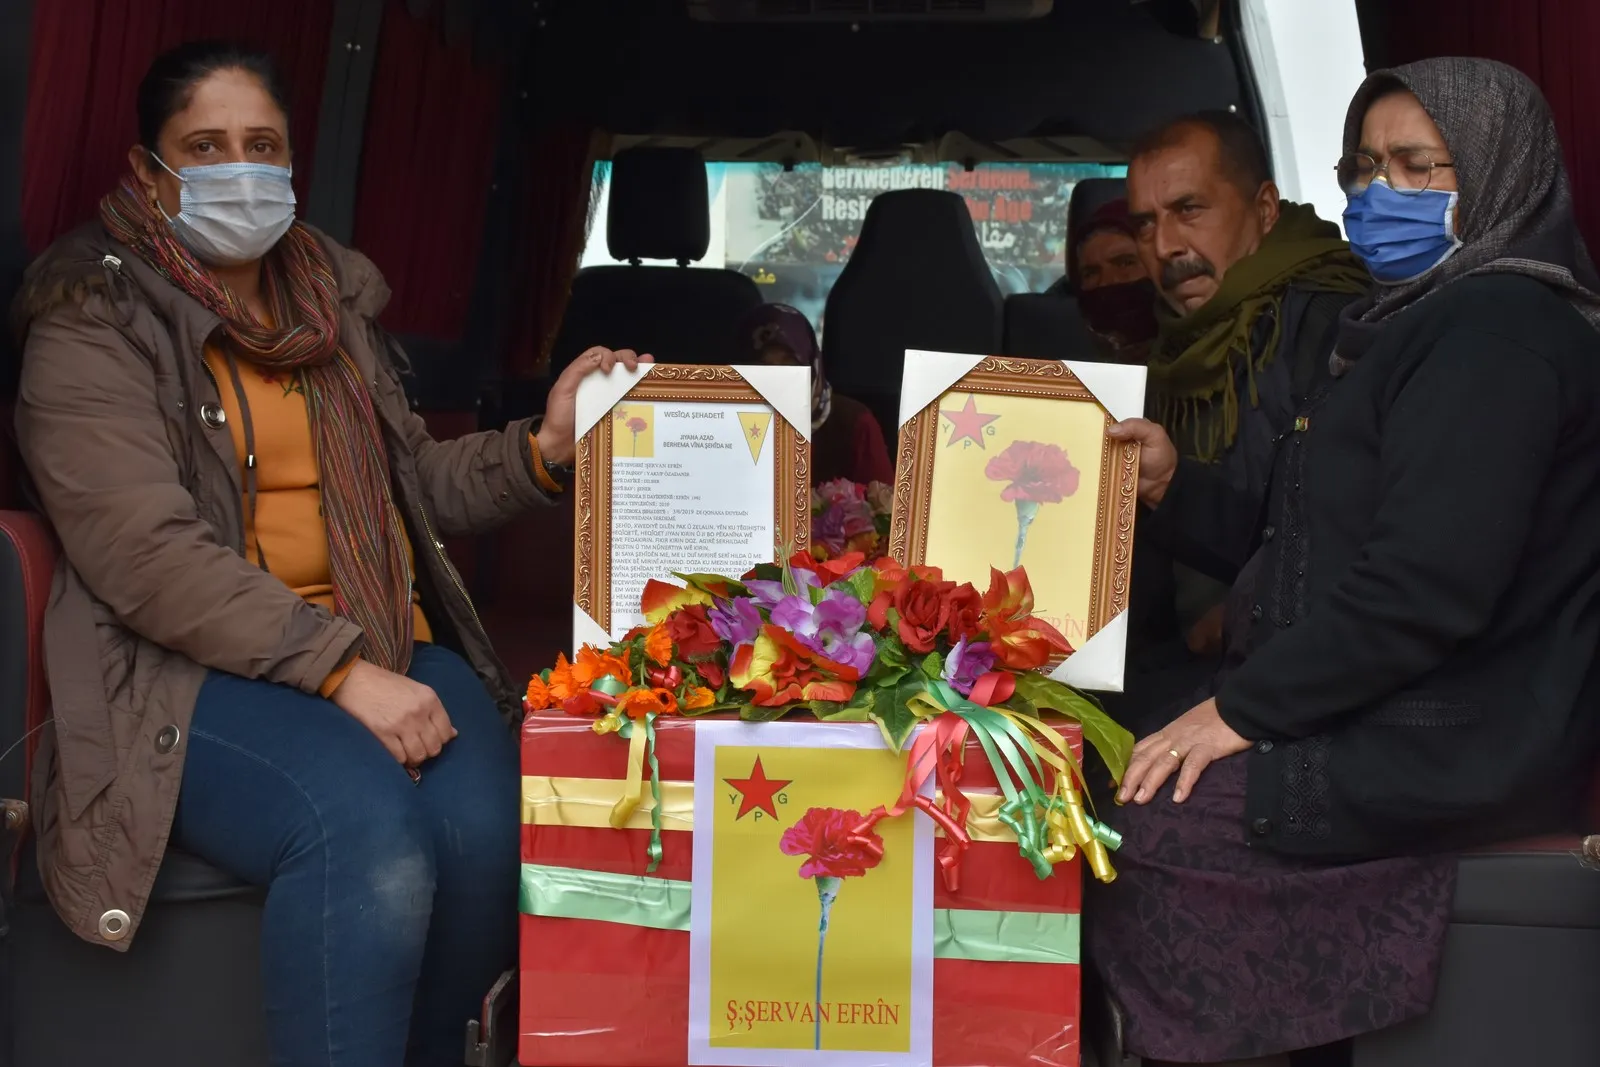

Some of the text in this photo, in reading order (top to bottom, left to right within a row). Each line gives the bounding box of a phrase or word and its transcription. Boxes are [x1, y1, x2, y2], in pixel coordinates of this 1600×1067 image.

[942, 423, 996, 450] Y P G
[729, 793, 788, 822] Y P G
[836, 998, 900, 1025] EFRÎN
